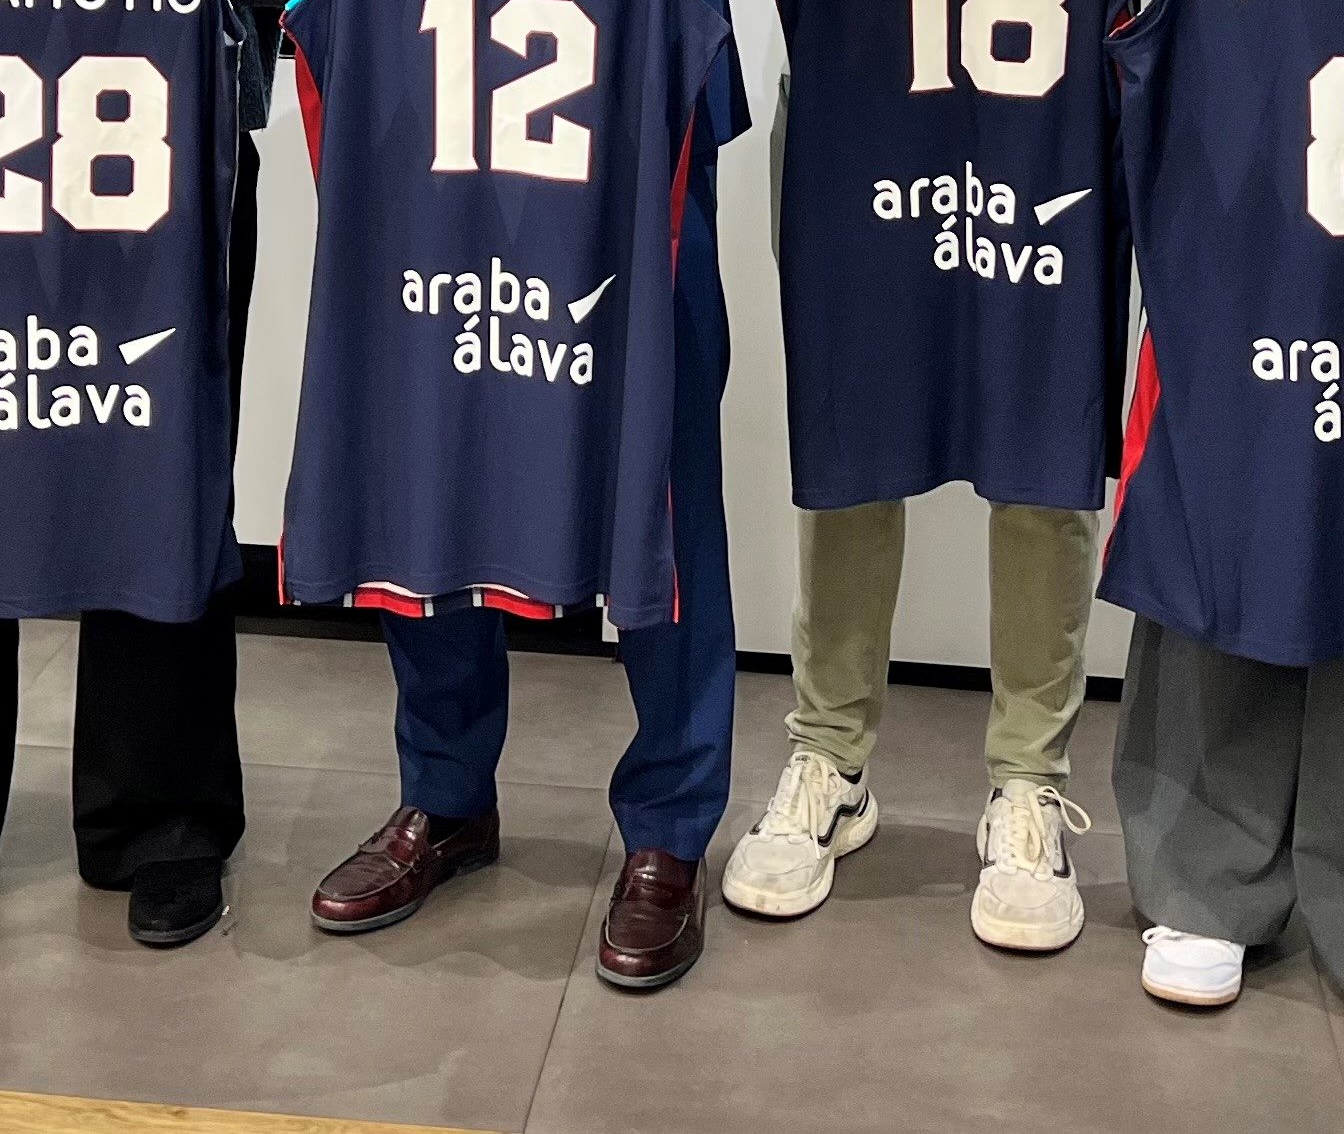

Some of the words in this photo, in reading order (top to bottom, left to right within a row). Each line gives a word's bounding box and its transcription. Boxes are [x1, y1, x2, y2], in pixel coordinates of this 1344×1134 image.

[872, 160, 1016, 225] araba
[933, 213, 1064, 286] álava
[402, 256, 550, 322] araba
[453, 313, 594, 385] álava
